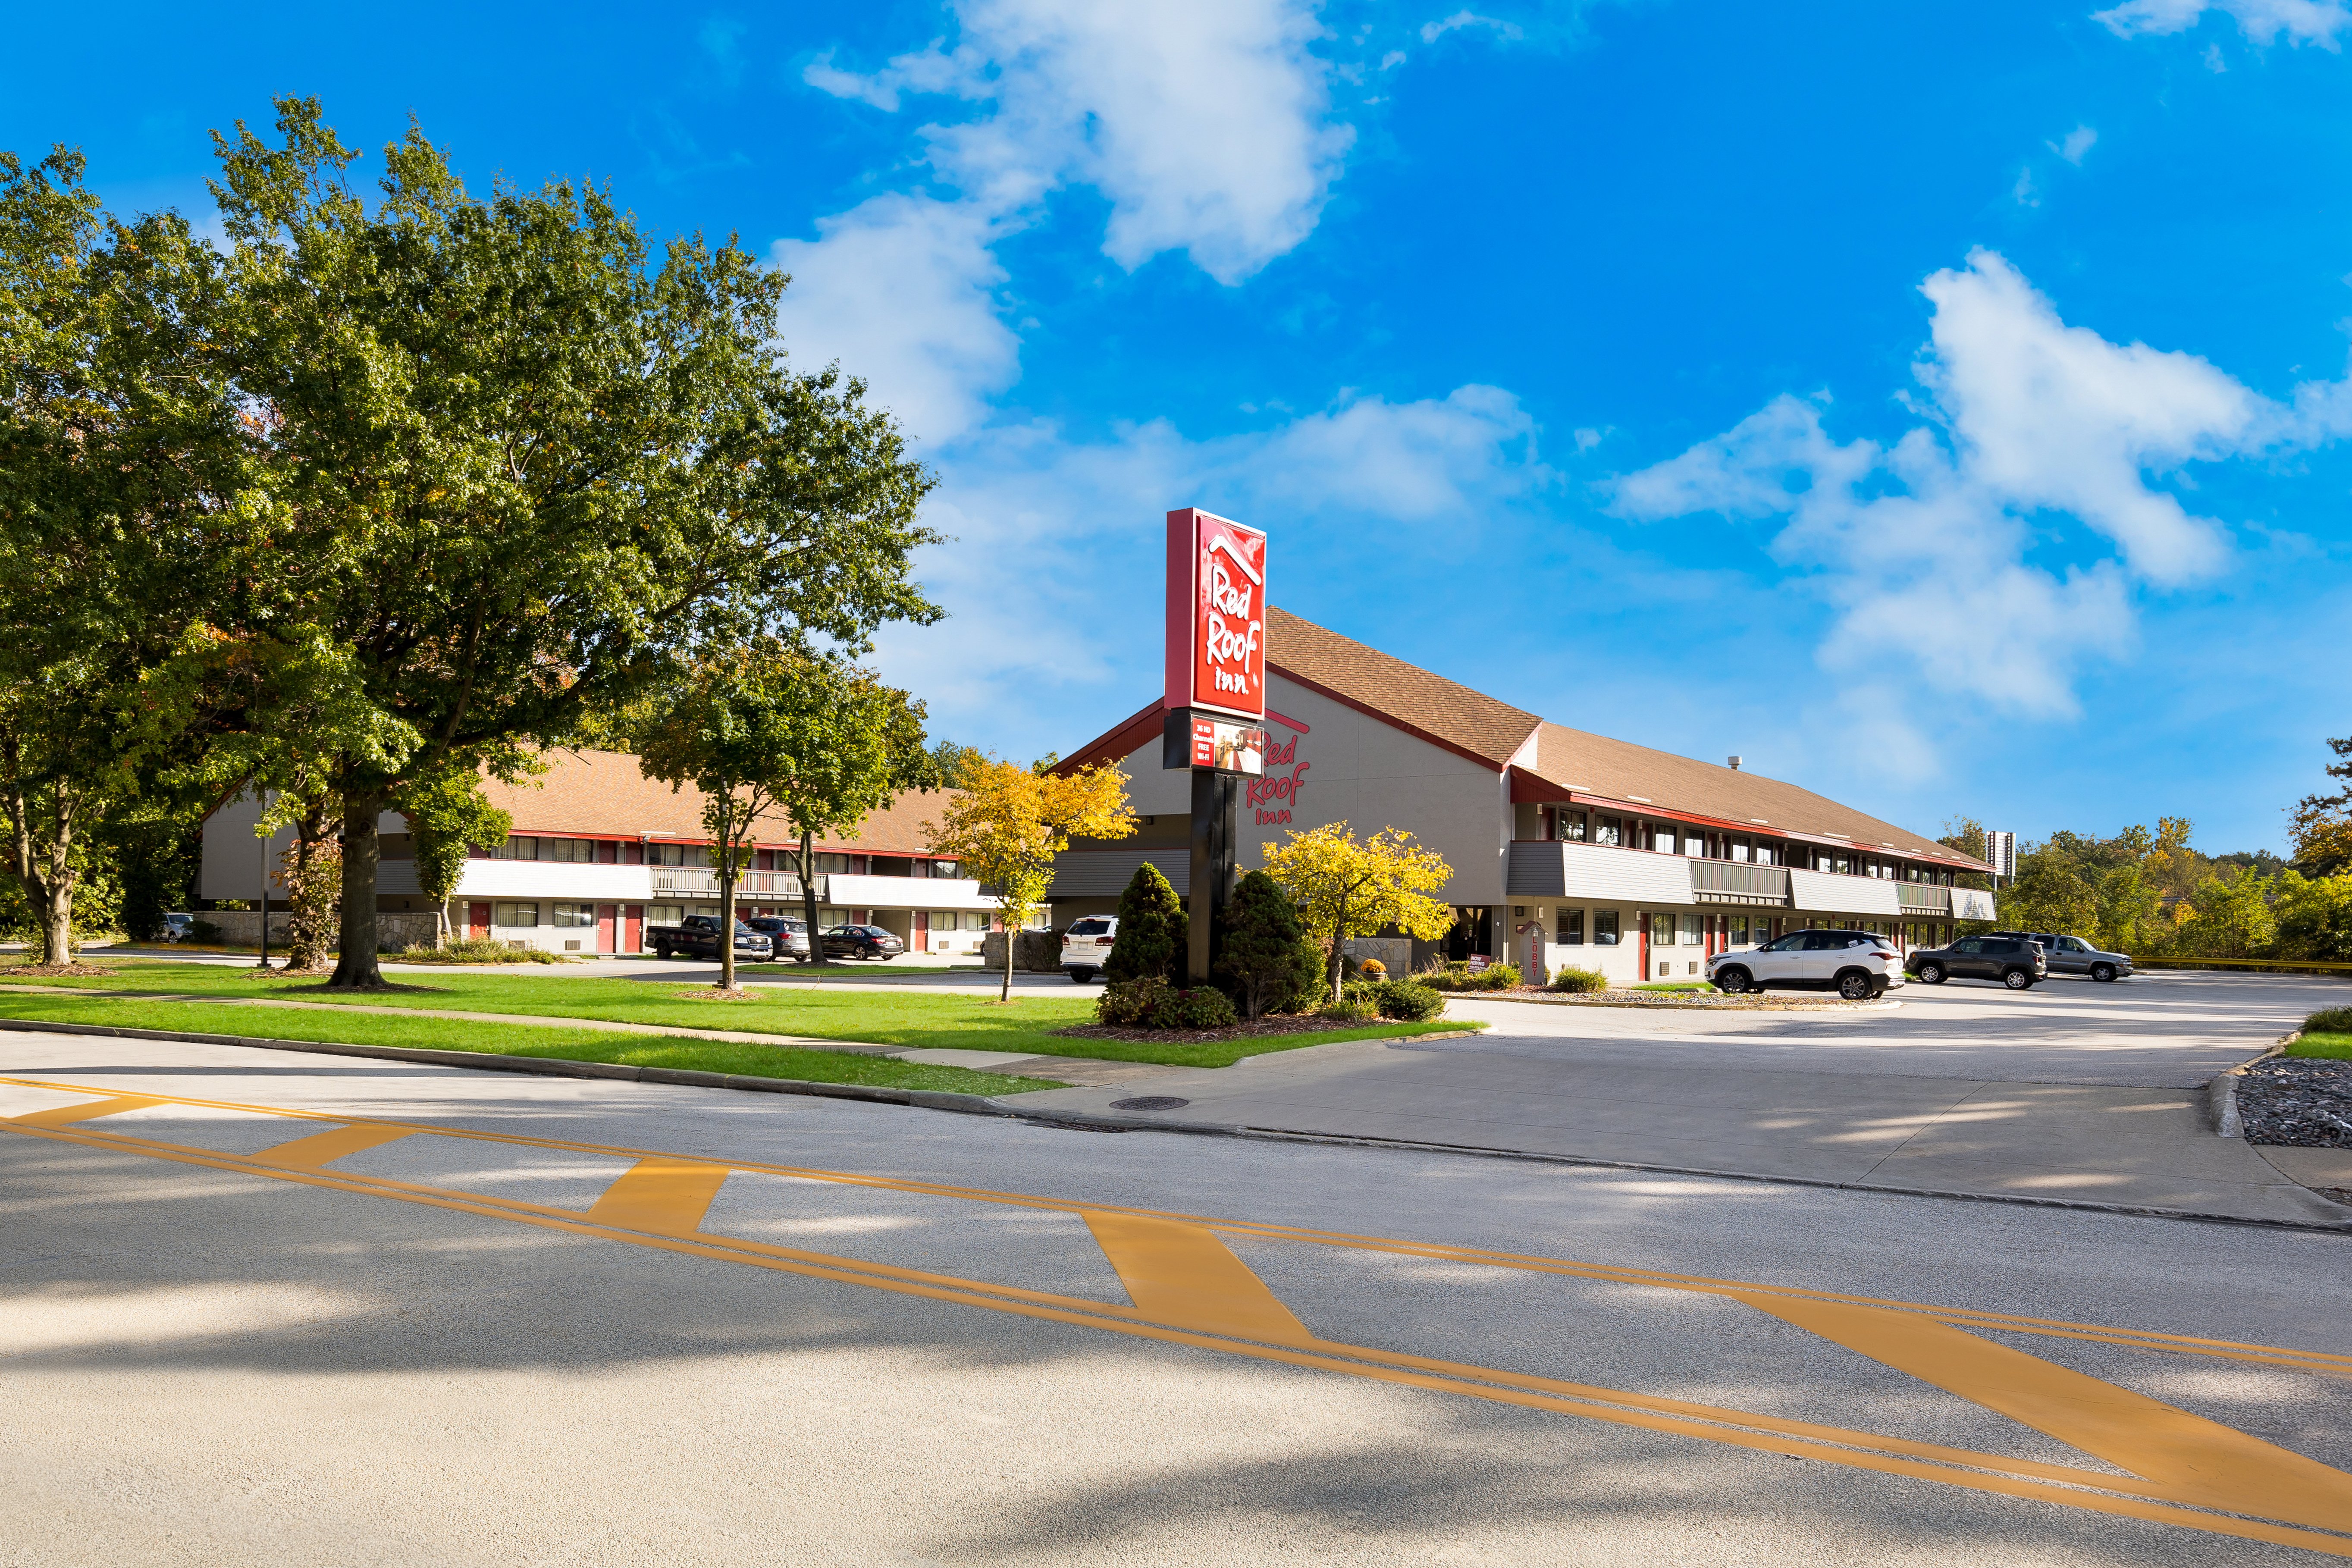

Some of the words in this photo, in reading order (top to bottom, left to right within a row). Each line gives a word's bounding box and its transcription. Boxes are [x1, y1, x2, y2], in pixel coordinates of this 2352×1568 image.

[1212, 563, 1252, 620] Red
[1207, 611, 1261, 674] Roof
[1193, 733, 1214, 743] Channels
[1198, 743, 1209, 751] FREE
[1197, 752, 1209, 761] Wi-Fi
[1246, 762, 1310, 808] Roof
